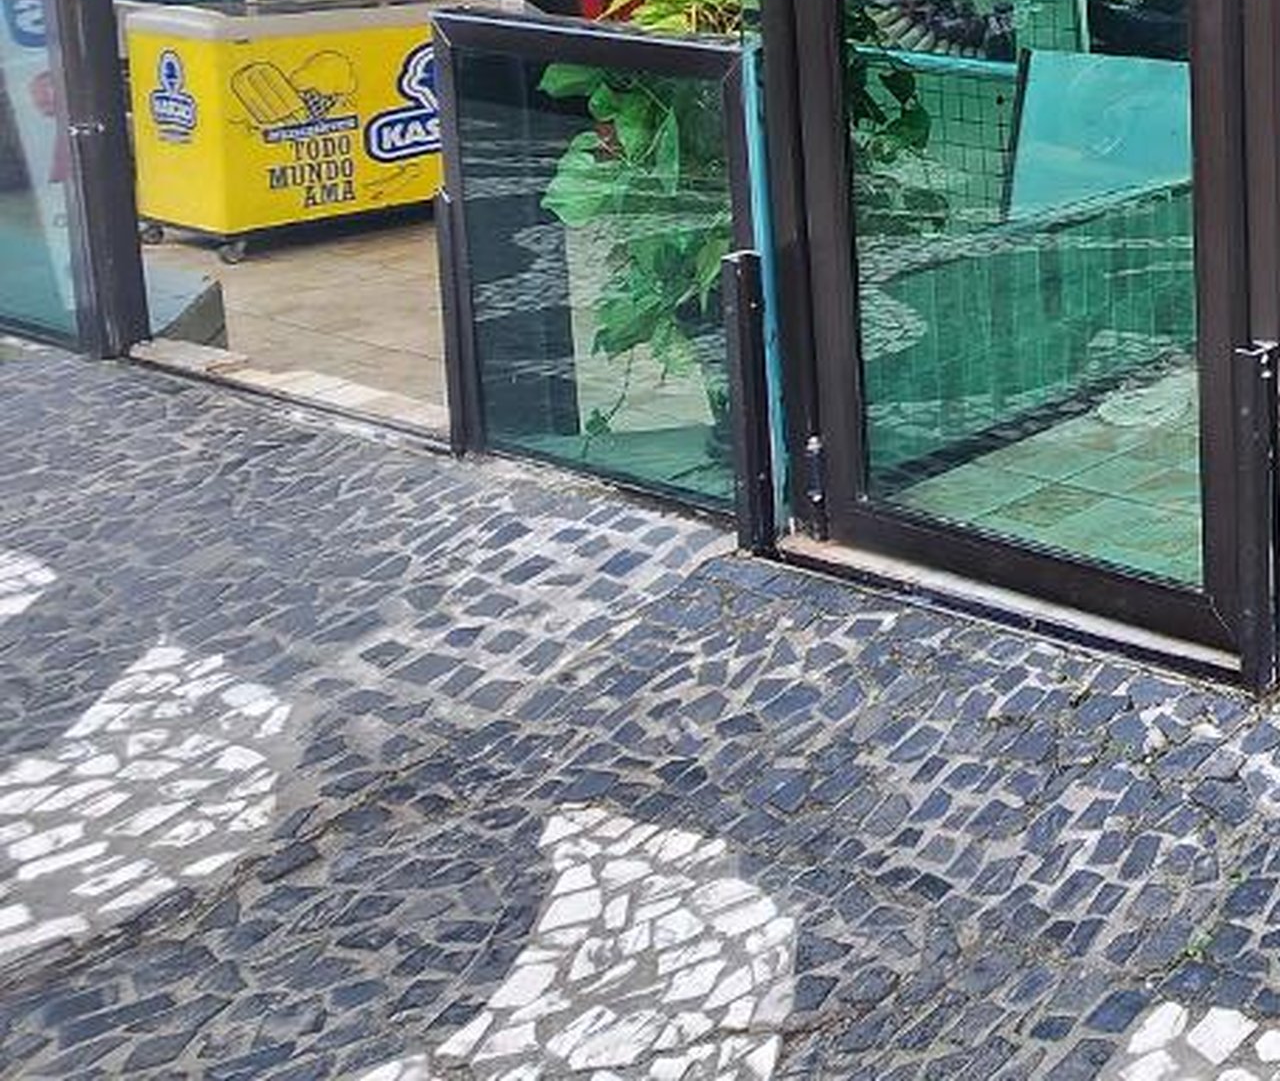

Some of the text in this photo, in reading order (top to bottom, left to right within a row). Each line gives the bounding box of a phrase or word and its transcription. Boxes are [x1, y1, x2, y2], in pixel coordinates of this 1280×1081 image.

[290, 134, 351, 161] TODO
[380, 117, 441, 151] KAS
[269, 160, 355, 190] MUNDO
[304, 180, 356, 207] AMA
